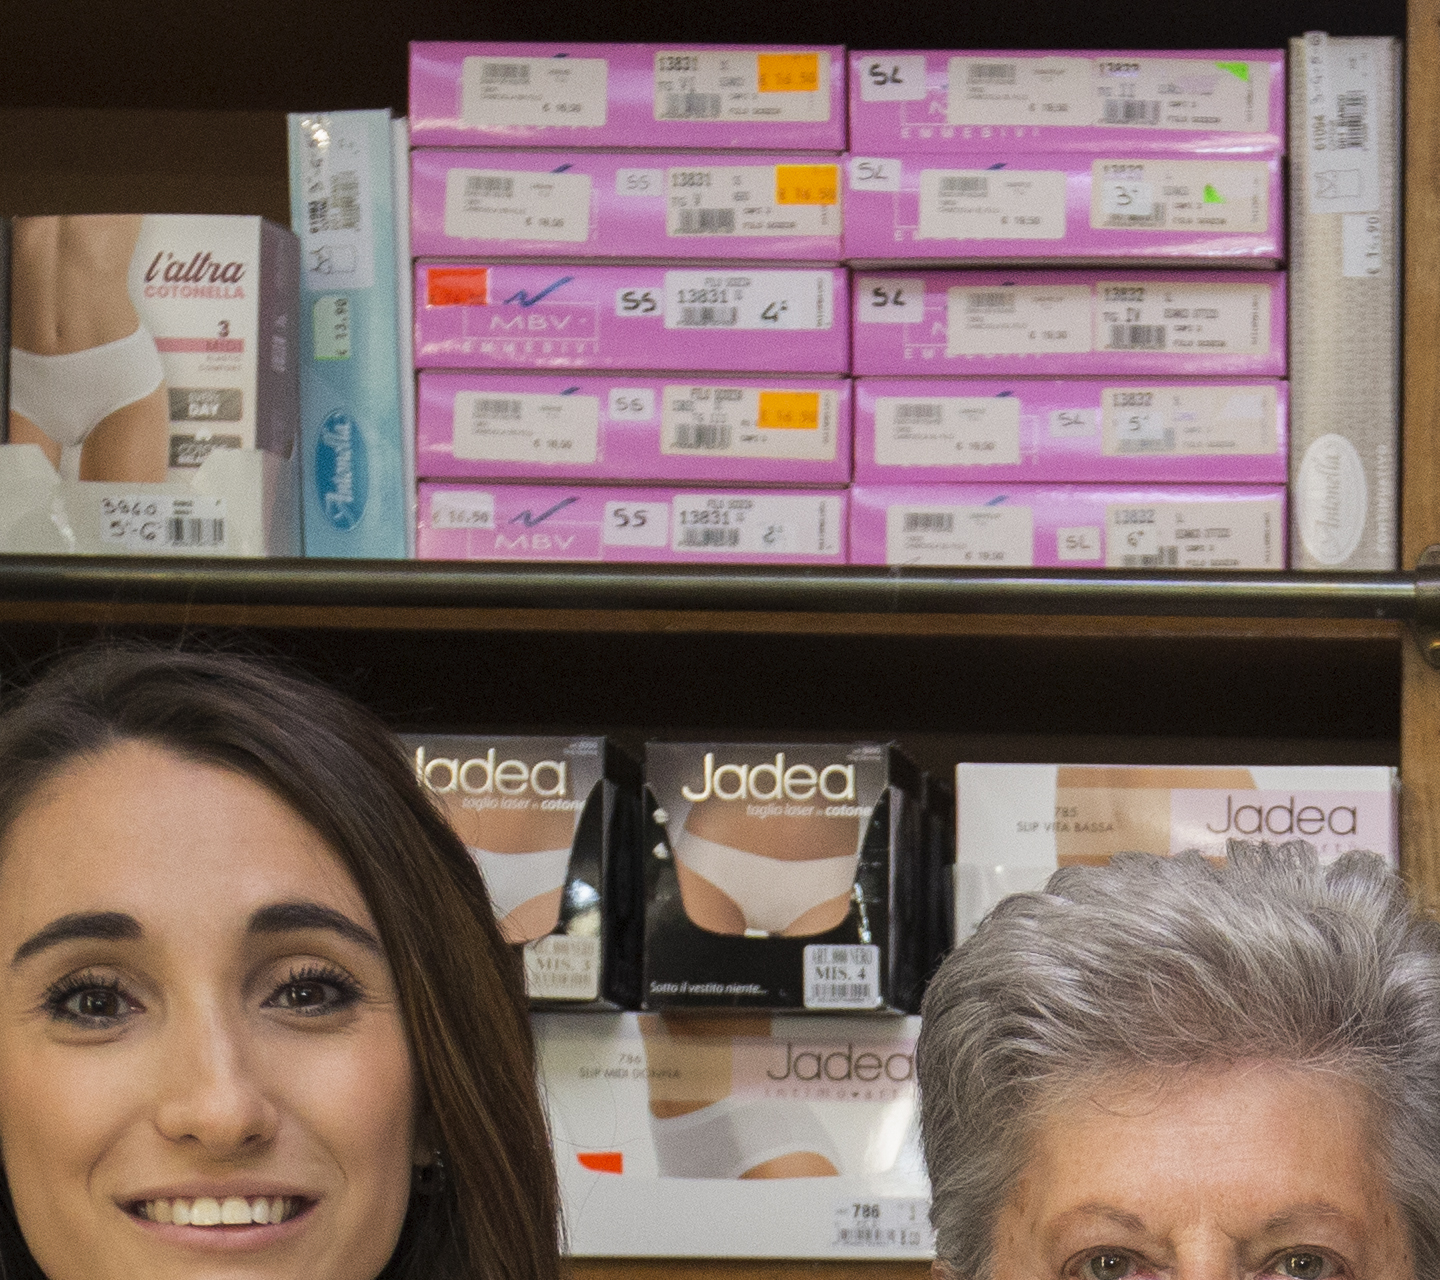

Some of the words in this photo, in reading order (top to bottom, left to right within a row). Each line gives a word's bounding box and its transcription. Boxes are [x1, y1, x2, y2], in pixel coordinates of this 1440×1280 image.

[144, 250, 245, 284] l'altra
[143, 282, 245, 299] COTONELLA
[682, 753, 856, 801] Jadea
[1207, 795, 1358, 838] Jadea
[649, 982, 676, 994] Sotto
[768, 1043, 915, 1082] Jadea
